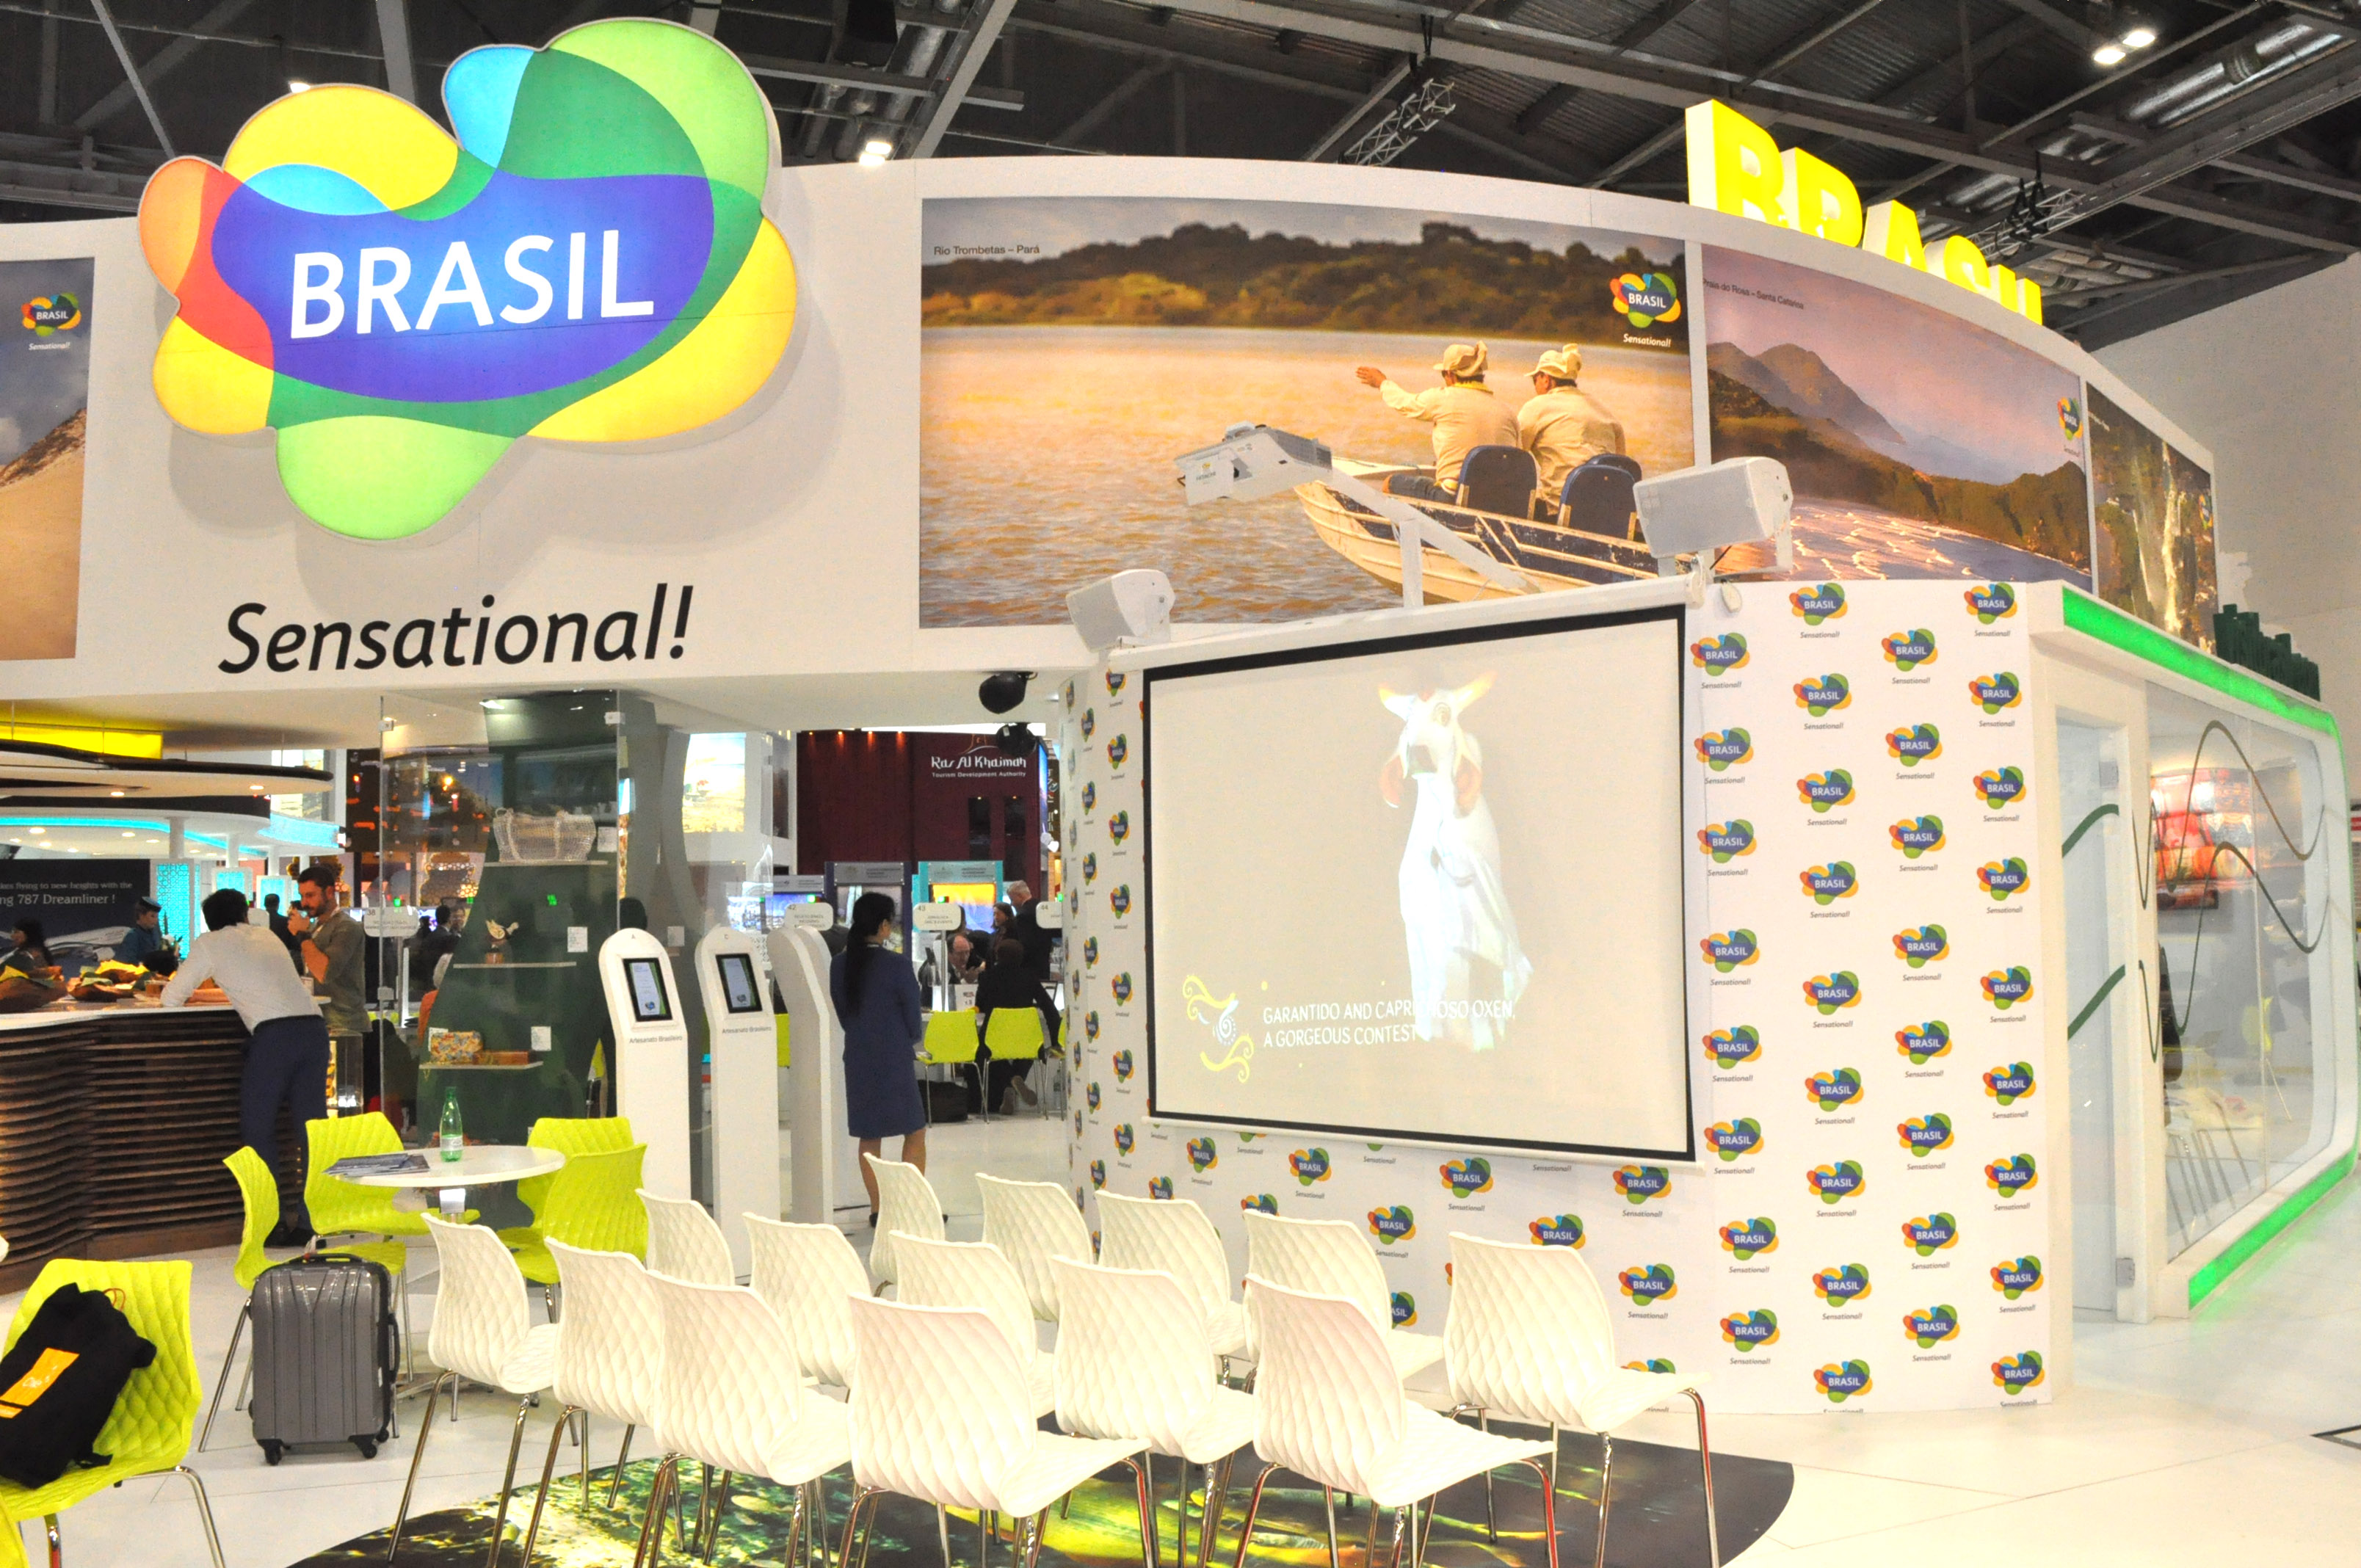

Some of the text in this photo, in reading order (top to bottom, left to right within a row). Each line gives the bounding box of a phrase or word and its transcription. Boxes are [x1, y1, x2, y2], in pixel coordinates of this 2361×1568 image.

[934, 246, 951, 255] Rio
[953, 245, 1006, 255] Trombetas
[1016, 244, 1040, 254] Pará
[291, 230, 654, 338] BRASIL
[1628, 292, 1667, 309] BRASIL
[1756, 290, 1777, 302] Santa
[36, 311, 69, 320] BRASIL
[1622, 333, 1672, 348] Sensational!
[29, 341, 71, 351] Sensational!
[1804, 600, 1836, 609] BRASIL
[1977, 599, 2007, 609] BRASIL
[219, 584, 692, 673] Sensational!
[1974, 629, 2011, 637] Sensational!
[1799, 631, 1840, 639] Sensational!
[1705, 650, 1738, 660] BRASIL
[1896, 645, 1927, 656] BRASIL
[1700, 680, 1742, 690] Sensational!
[1891, 677, 1931, 685] Sensational!
[1807, 691, 1840, 700] BRASIL
[1982, 689, 2012, 698] BRASIL
[1804, 722, 1844, 730] Sensational!
[1979, 719, 2015, 727] Sensational!
[1709, 745, 1742, 755] BRASIL
[1900, 741, 1932, 750] BRASIL
[931, 755, 1026, 769] Ras Al Khaimah
[1703, 776, 1746, 785] Sensational!
[1896, 772, 1935, 780] Sensational!
[1811, 786, 1844, 796] BRASIL
[1987, 783, 2016, 793] BRASIL
[1807, 818, 1848, 826] Sensational!
[1903, 832, 1934, 842] BRASIL
[1712, 837, 1745, 847] BRASIL
[1899, 863, 1938, 872] Sensational!
[1706, 868, 1749, 877] Sensational!
[1814, 879, 1847, 889] BRASIL
[1990, 875, 2020, 885] BRASIL
[18, 894, 39, 904] 787
[43, 893, 109, 904] Dreamliner
[1810, 910, 1851, 918] Sensational!
[1986, 906, 2023, 914] Sensational!
[1715, 946, 1748, 957] BRASIL
[1907, 942, 1938, 952] BRASIL
[1902, 973, 1942, 981] Sensational!
[1709, 978, 1752, 987] Sensational!
[1994, 984, 2023, 993] BRASIL
[1817, 989, 1850, 998] BRASIL
[1263, 1003, 1340, 1024] GARANTIDO
[1343, 1002, 1372, 1020] AND
[1375, 999, 1469, 1019] CAPRIOSO
[1990, 1015, 2027, 1023] Sensational!
[1813, 1020, 1854, 1028] Sensational!
[629, 1036, 657, 1044] Artesanato
[1263, 1031, 1273, 1048] A
[1276, 1027, 1351, 1048] GORGEOUS
[1909, 1038, 1941, 1048] BRASIL
[1717, 1043, 1750, 1053] BRASIL
[1712, 1074, 1754, 1083] Sensational!
[1904, 1070, 1944, 1078] Sensational!
[1996, 1079, 2026, 1089] BRASIL
[1819, 1085, 1852, 1095] BRASIL
[1992, 1110, 2029, 1119] Sensational!
[1814, 1117, 1856, 1125] Sensational!
[1911, 1130, 1943, 1141] BRASIL
[1719, 1136, 1752, 1145] BRASIL
[1194, 1150, 1211, 1161] BRASIL
[1363, 1156, 1396, 1164] Sensational!
[1299, 1163, 1323, 1172] BRASIL
[1533, 1164, 1571, 1172] Sensational!
[1713, 1166, 1755, 1175] Sensational!
[1907, 1162, 1946, 1171] Sensational!
[1452, 1174, 1482, 1183] BRASIL
[1998, 1172, 2028, 1182] BRASIL
[1627, 1179, 1660, 1188] BRASIL
[1821, 1178, 1854, 1188] BRASIL
[1448, 1203, 1484, 1211] Sensational!
[1993, 1202, 2031, 1211] Sensational!
[1622, 1209, 1663, 1218] Sensational!
[1816, 1209, 1857, 1217] Sensational!
[1379, 1220, 1407, 1231] BRASIL
[1543, 1231, 1574, 1241] BRASIL
[1733, 1235, 1767, 1244] BRASIL
[1915, 1230, 1948, 1241] BRASIL
[1728, 1266, 1770, 1274] Sensational!
[1911, 1261, 1951, 1270] Sensational!
[2003, 1273, 2034, 1284] BRASIL
[1633, 1280, 1666, 1291] BRASIL
[1827, 1281, 1860, 1291] BRASIL
[1392, 1307, 1407, 1317] ASIL
[1999, 1304, 2036, 1313] Sensational!
[1628, 1311, 1669, 1319] Sensational!
[1821, 1313, 1863, 1321] Sensational!
[1735, 1326, 1768, 1336] BRASIL
[1917, 1322, 1949, 1332] BRASIL
[1912, 1354, 1951, 1362] Sensational!
[2004, 1368, 2034, 1379] BRASIL
[1828, 1376, 1861, 1387] BRASIL
